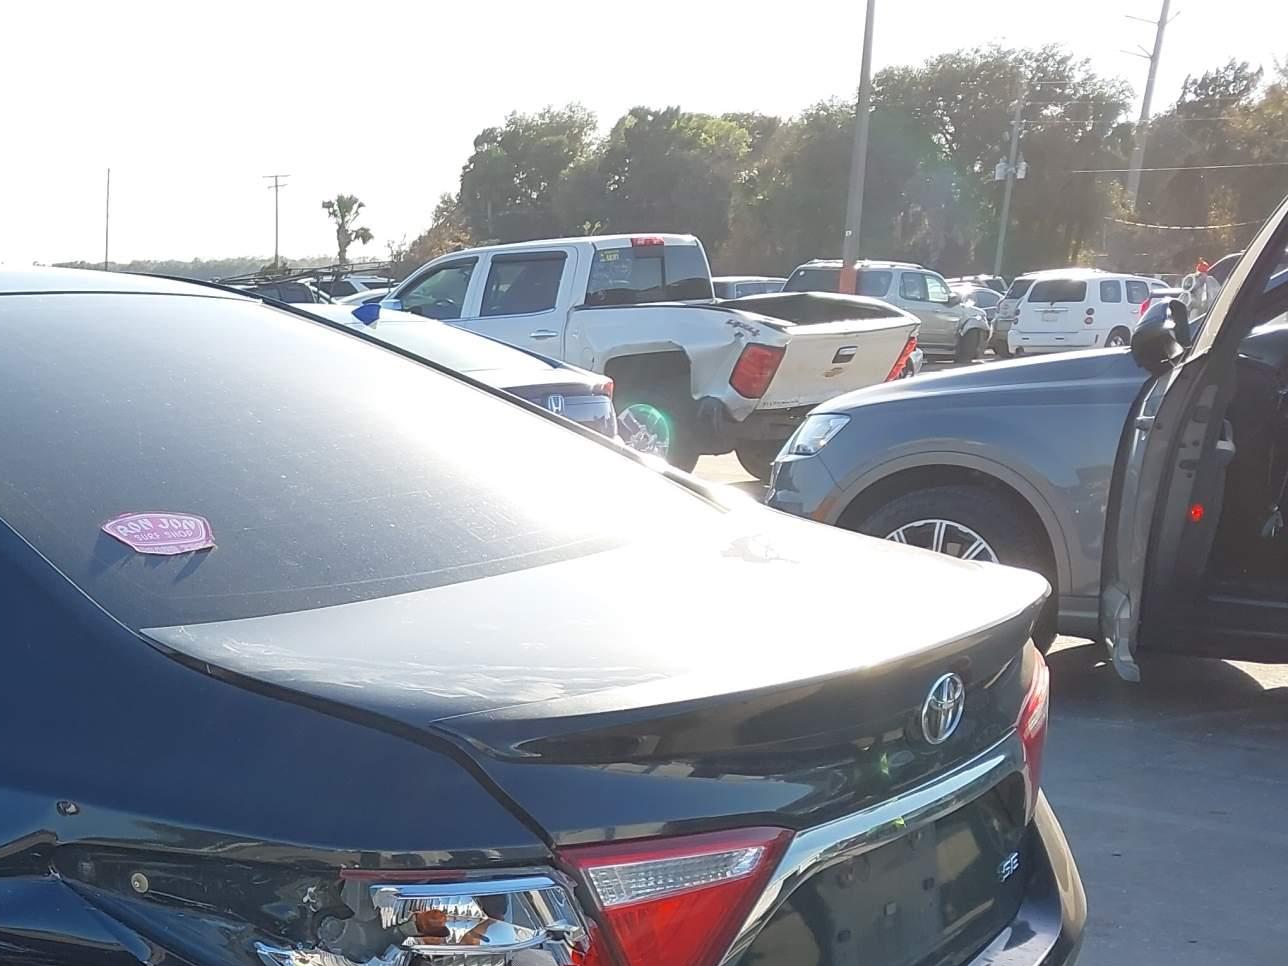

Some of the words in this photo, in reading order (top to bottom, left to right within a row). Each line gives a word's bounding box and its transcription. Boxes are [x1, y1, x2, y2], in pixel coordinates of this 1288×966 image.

[116, 518, 154, 537] RON
[158, 518, 197, 531] JON
[134, 531, 161, 541] SURF
[165, 529, 194, 539] SHOP
[1000, 852, 1020, 882] SE
